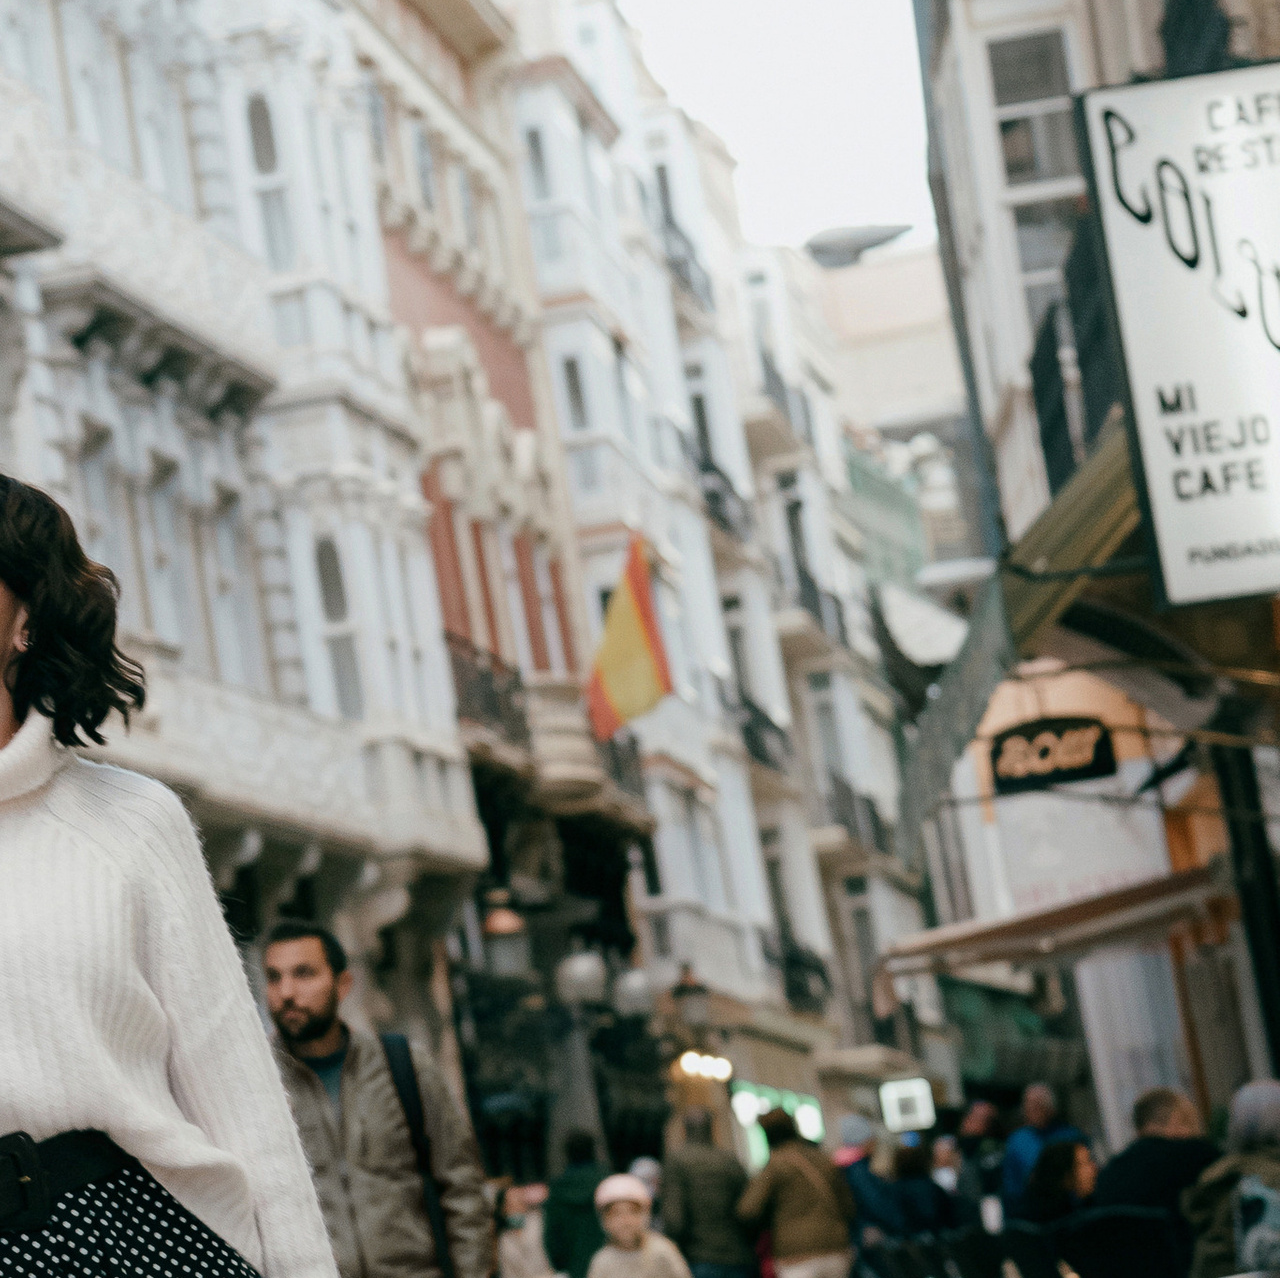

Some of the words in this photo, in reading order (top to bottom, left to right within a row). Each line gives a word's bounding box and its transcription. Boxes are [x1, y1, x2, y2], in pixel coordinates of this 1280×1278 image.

[1206, 91, 1280, 132] CAF
[1156, 382, 1197, 415] MI
[1164, 414, 1270, 456] VIEJO
[1173, 458, 1267, 501] CAFE
